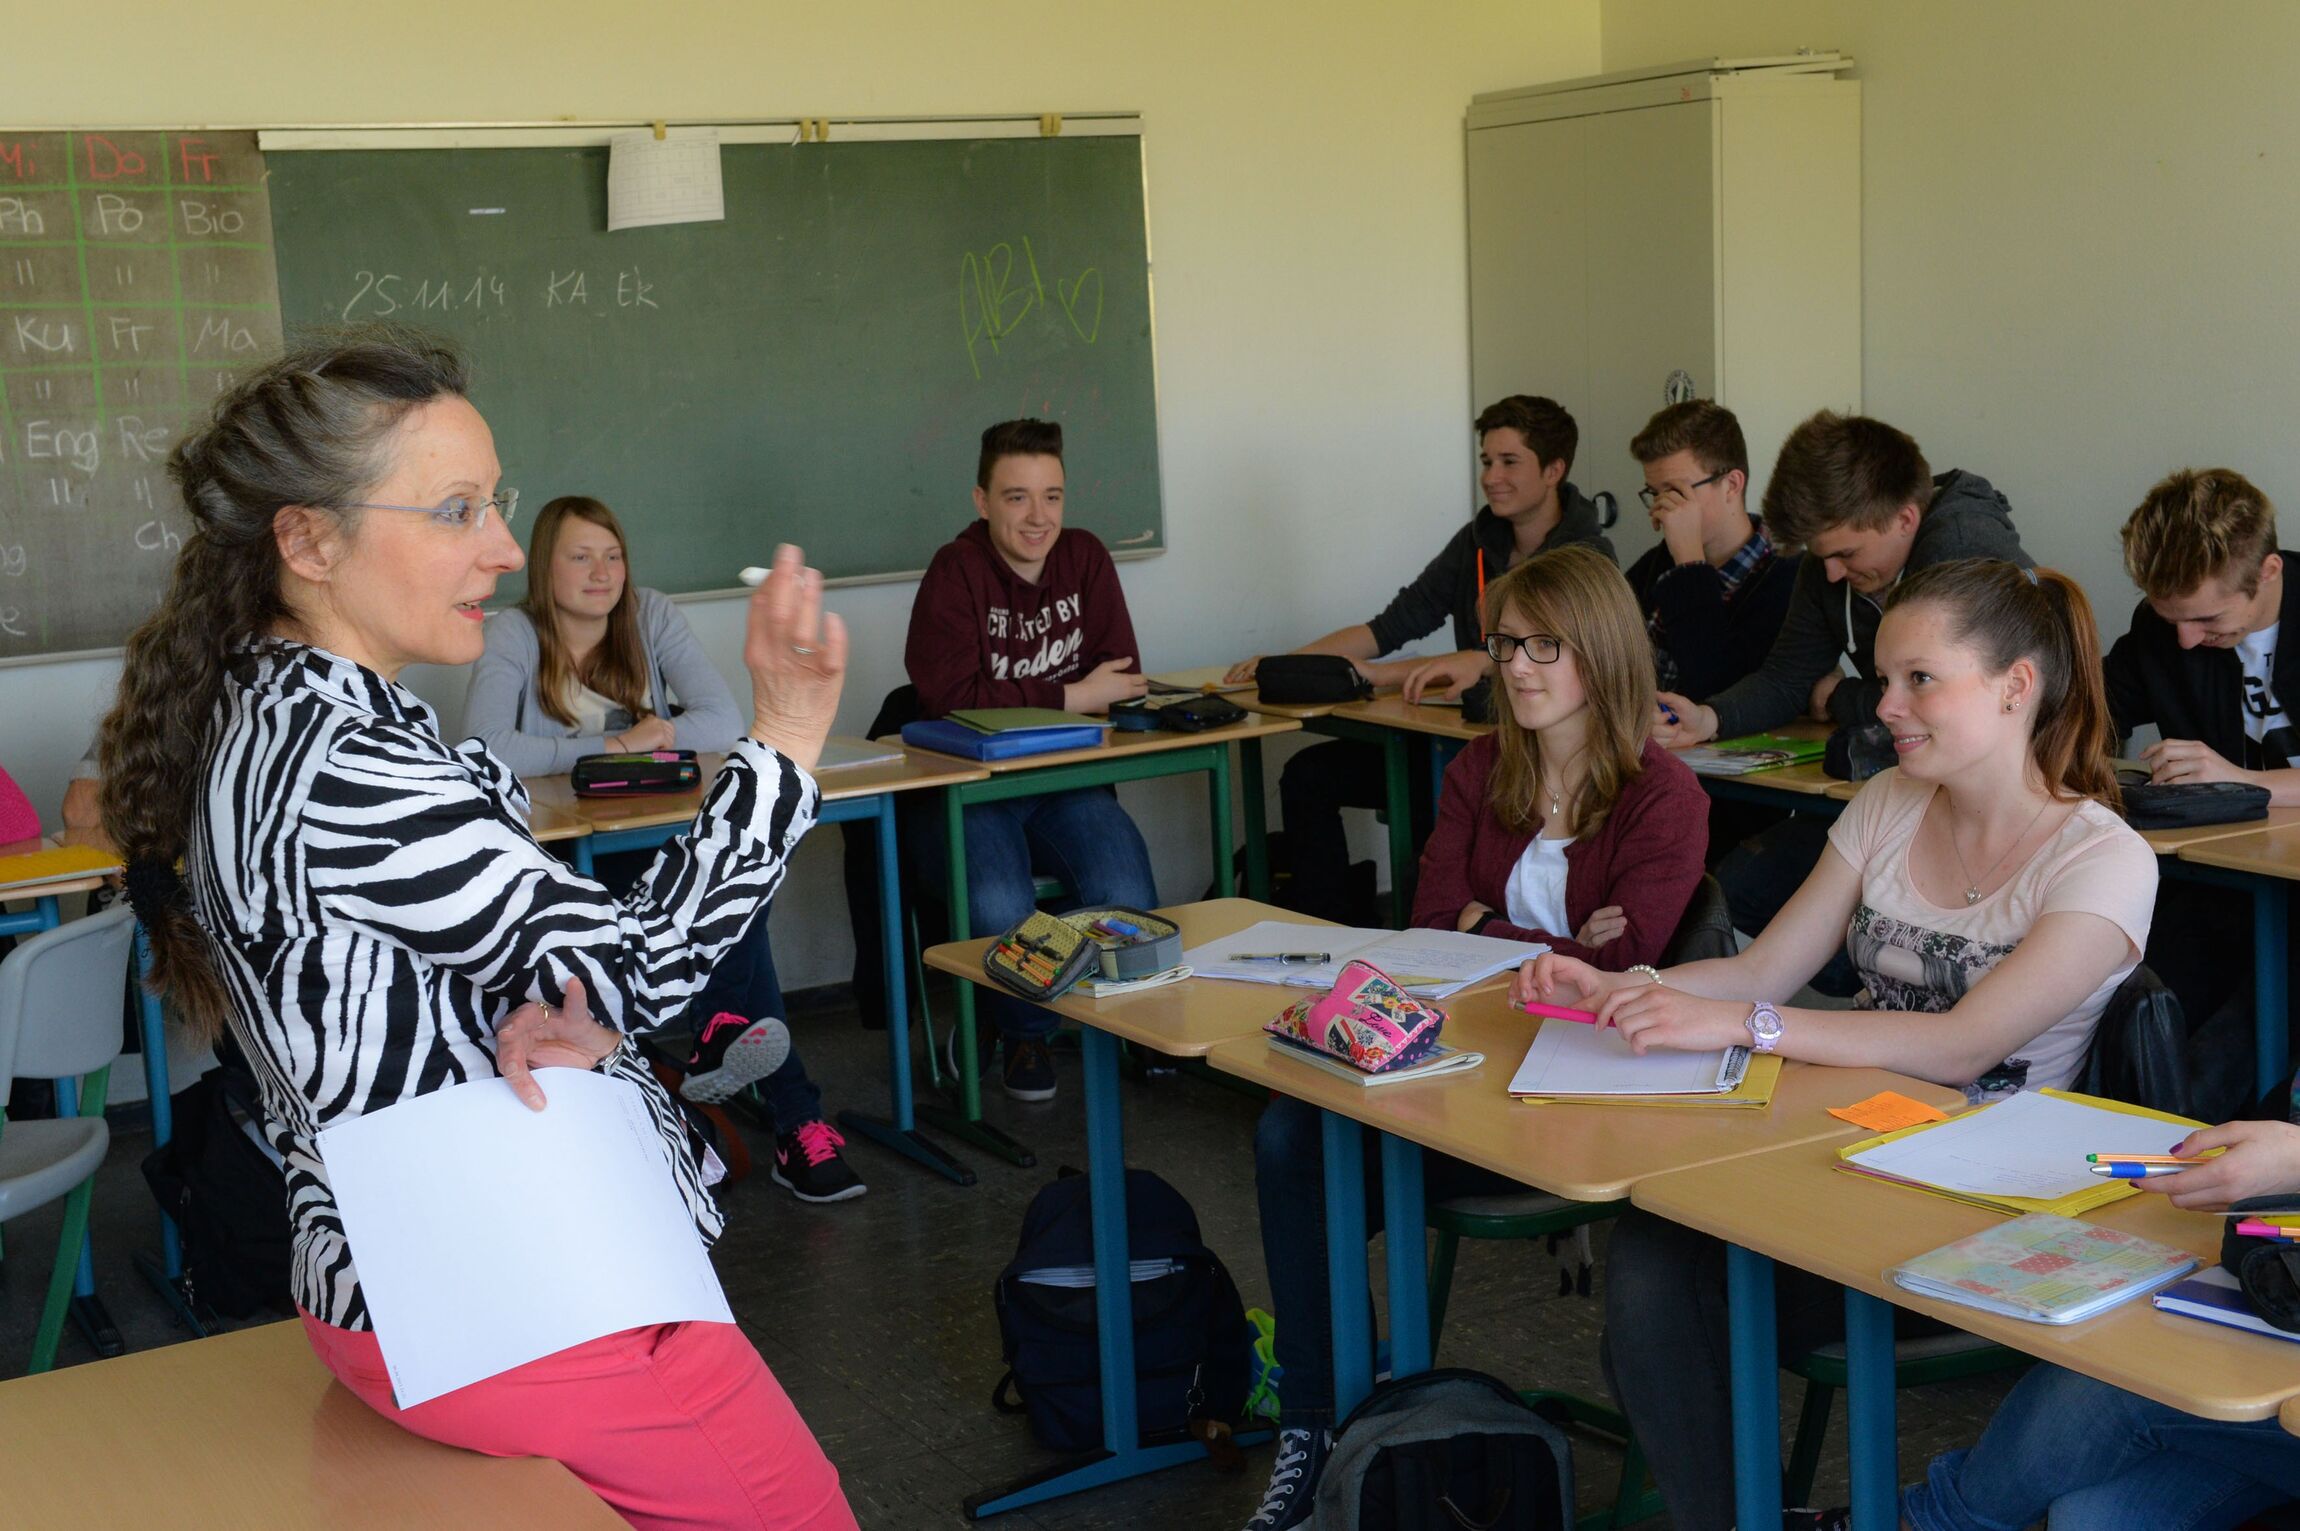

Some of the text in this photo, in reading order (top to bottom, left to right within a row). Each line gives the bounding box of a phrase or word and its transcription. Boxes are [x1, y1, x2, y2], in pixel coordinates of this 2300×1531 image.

[84, 134, 146, 181] Do
[180, 138, 220, 183] Fr
[181, 199, 244, 235] Bio
[547, 269, 588, 309] KA
[110, 315, 154, 352] Fr
[193, 315, 258, 353] Ma
[27, 418, 100, 475] Eng
[987, 592, 1080, 643] CRATED BY
